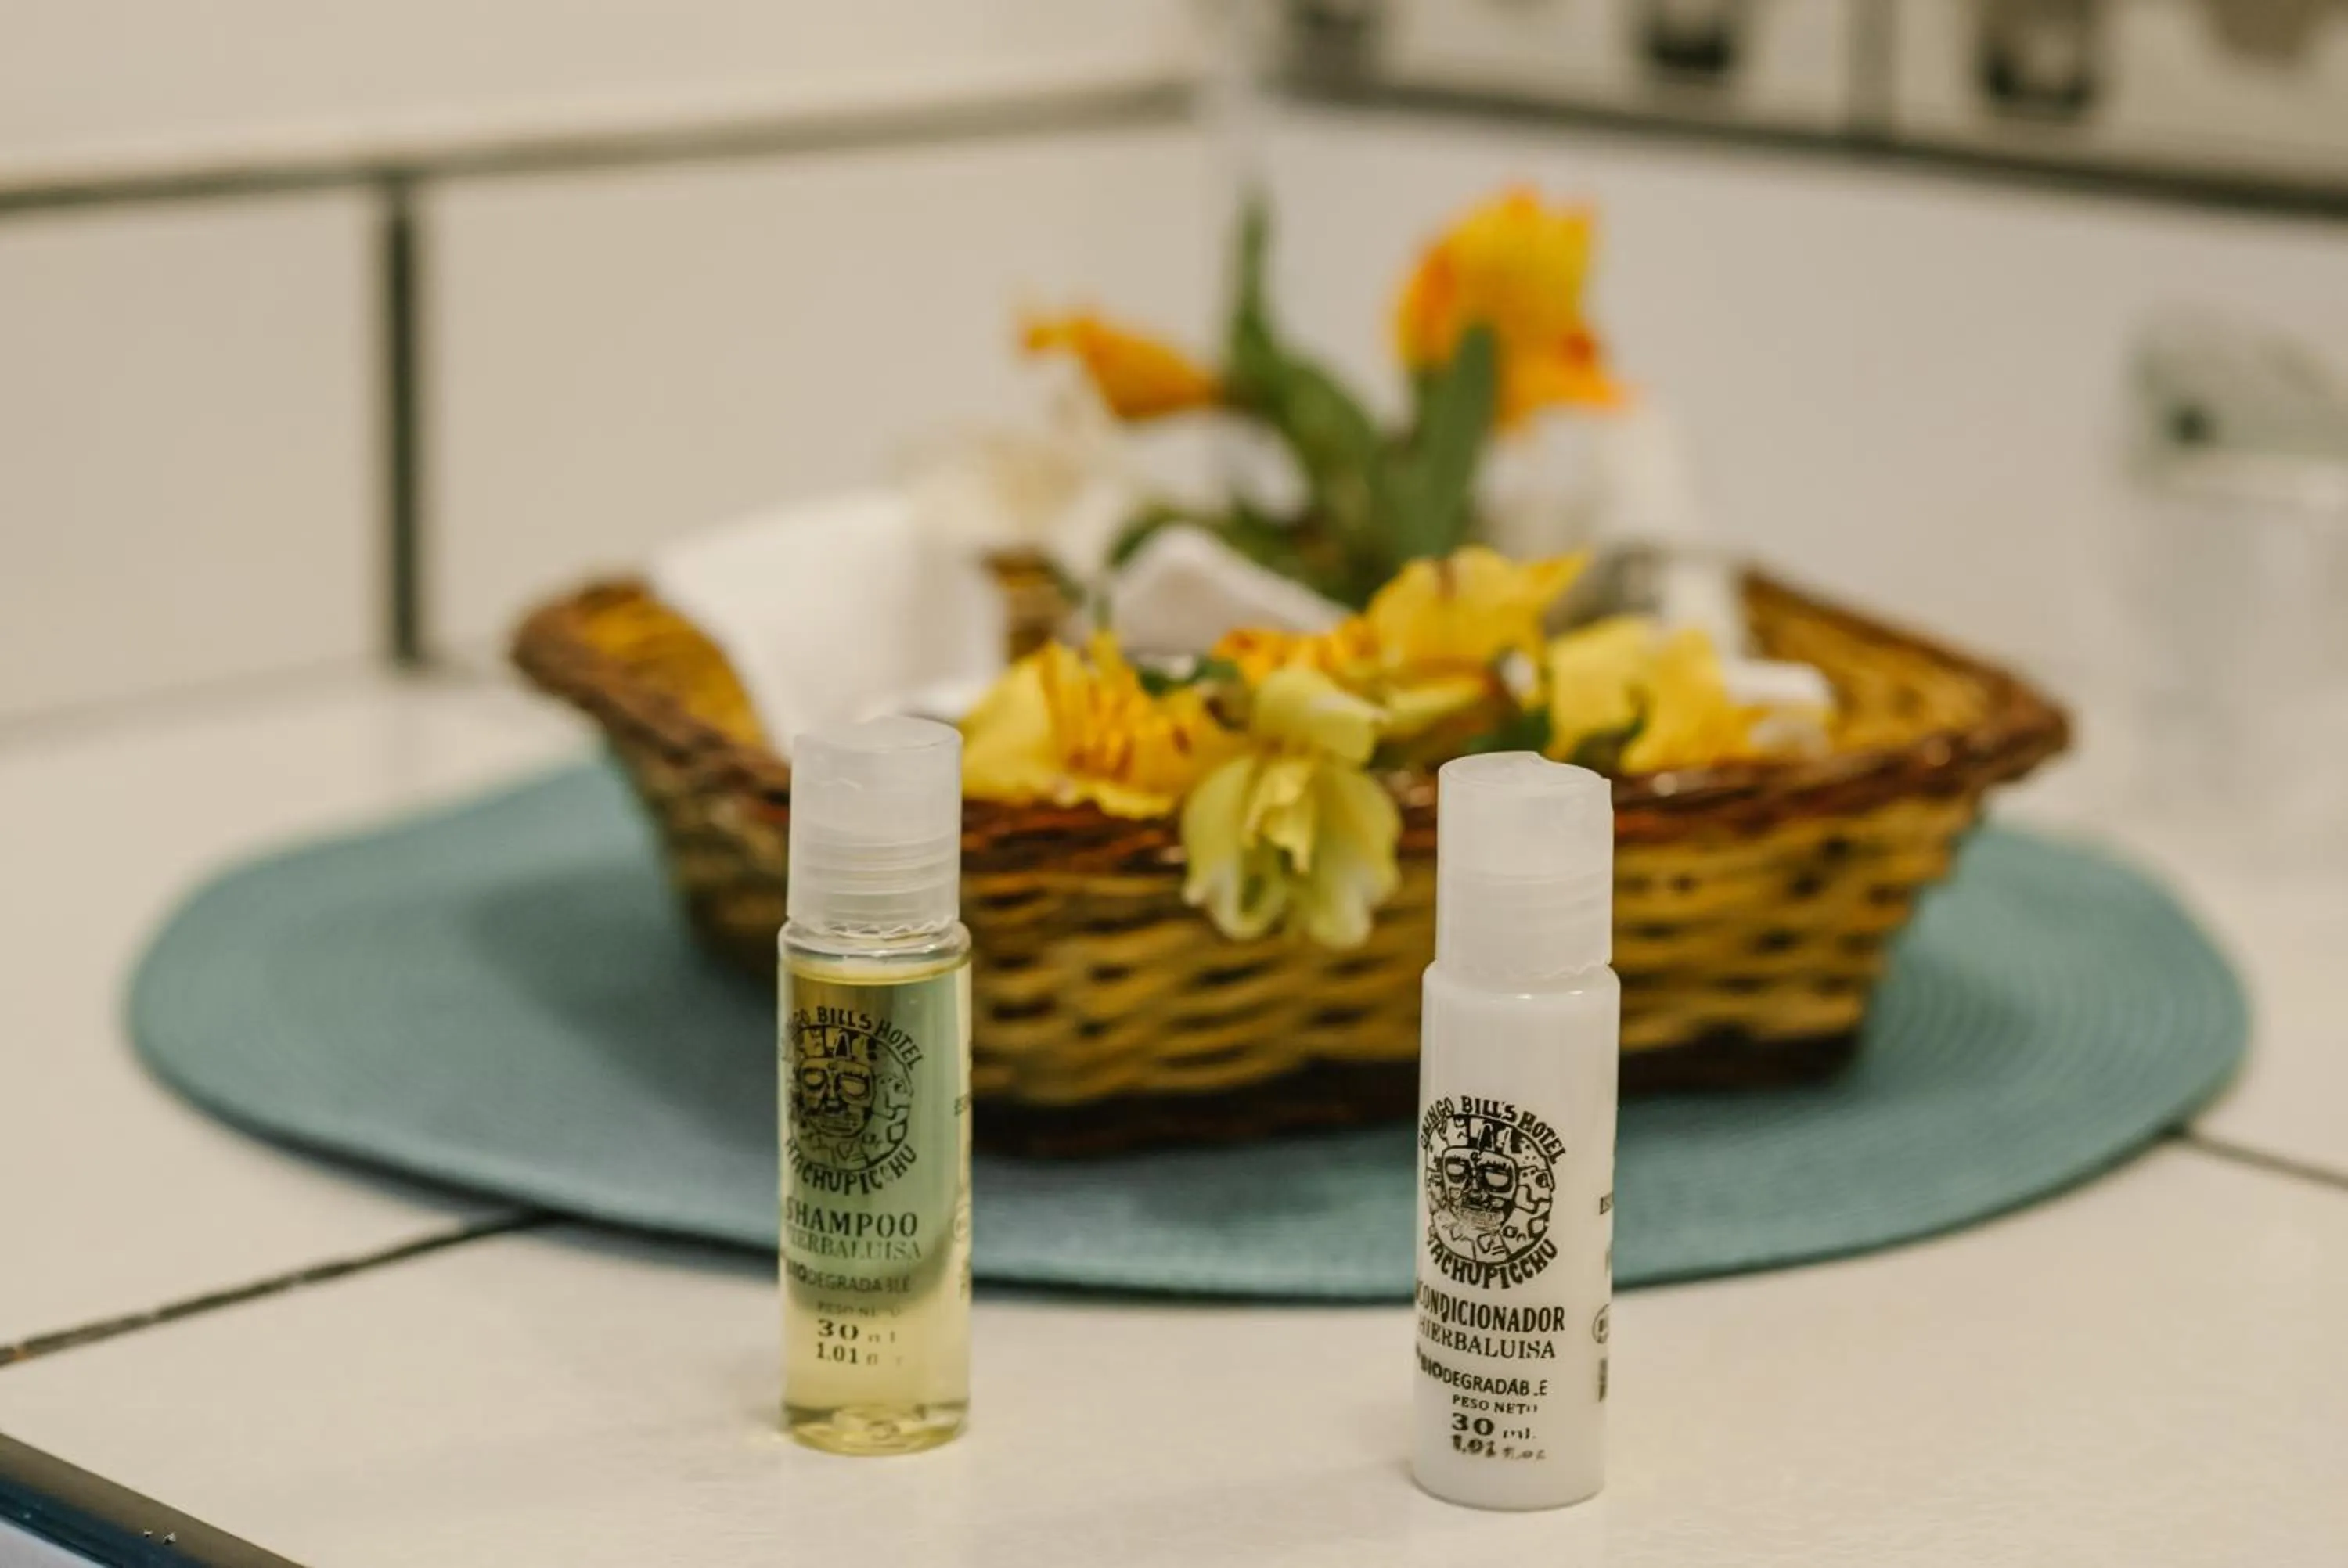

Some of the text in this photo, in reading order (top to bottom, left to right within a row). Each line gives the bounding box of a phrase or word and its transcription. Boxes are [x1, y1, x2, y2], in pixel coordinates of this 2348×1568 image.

[874, 1020, 923, 1071] HOTEL
[1461, 1095, 1518, 1123] BILL'S
[1518, 1110, 1566, 1165] HOTEL
[786, 1196, 917, 1238] SHAMPOO
[817, 1318, 859, 1340] 30
[1453, 1394, 1489, 1412] PESO
[1452, 1412, 1494, 1436] 30
